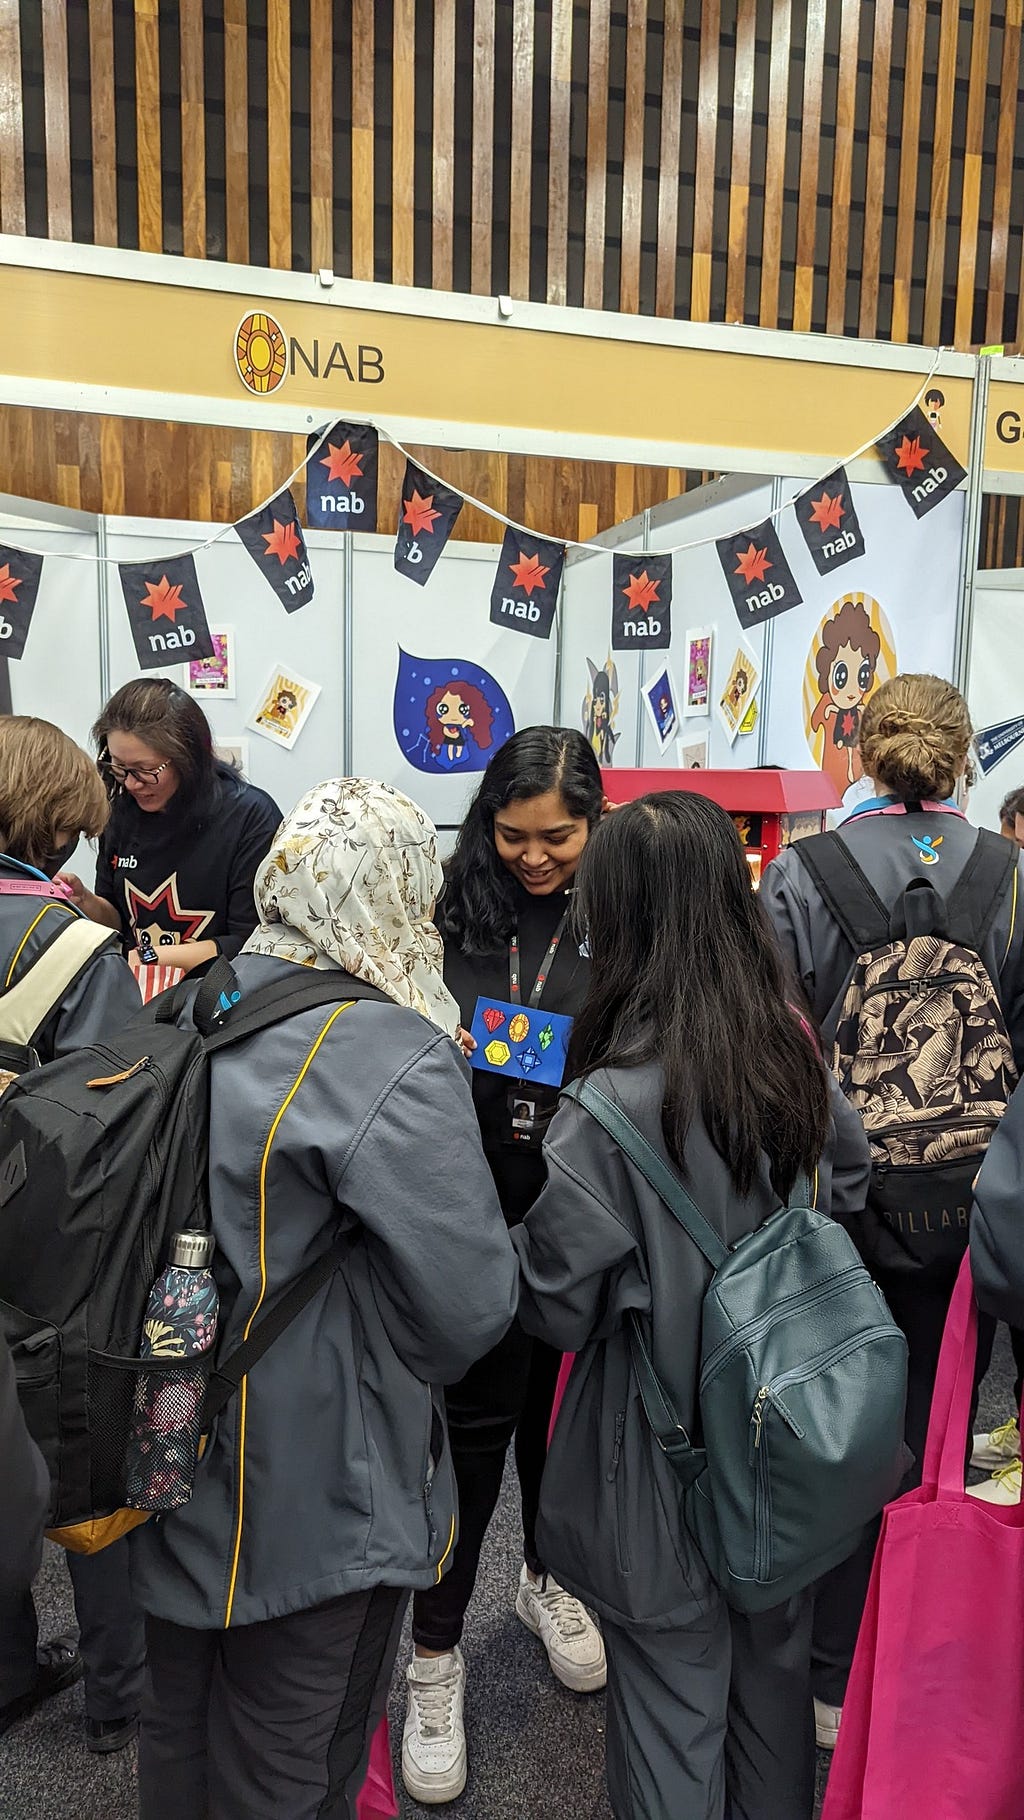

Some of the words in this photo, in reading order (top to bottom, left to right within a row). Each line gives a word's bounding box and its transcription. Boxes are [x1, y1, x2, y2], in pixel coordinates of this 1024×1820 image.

[290, 337, 385, 384] NAB
[996, 410, 1024, 444] G
[911, 465, 949, 503] nab
[321, 492, 365, 514] nab
[822, 530, 857, 559] nab
[501, 597, 541, 622] nab
[745, 582, 786, 613] nab
[149, 625, 196, 652] nab
[624, 616, 662, 637] nab
[117, 855, 138, 869] nab
[535, 980, 543, 992] nab
